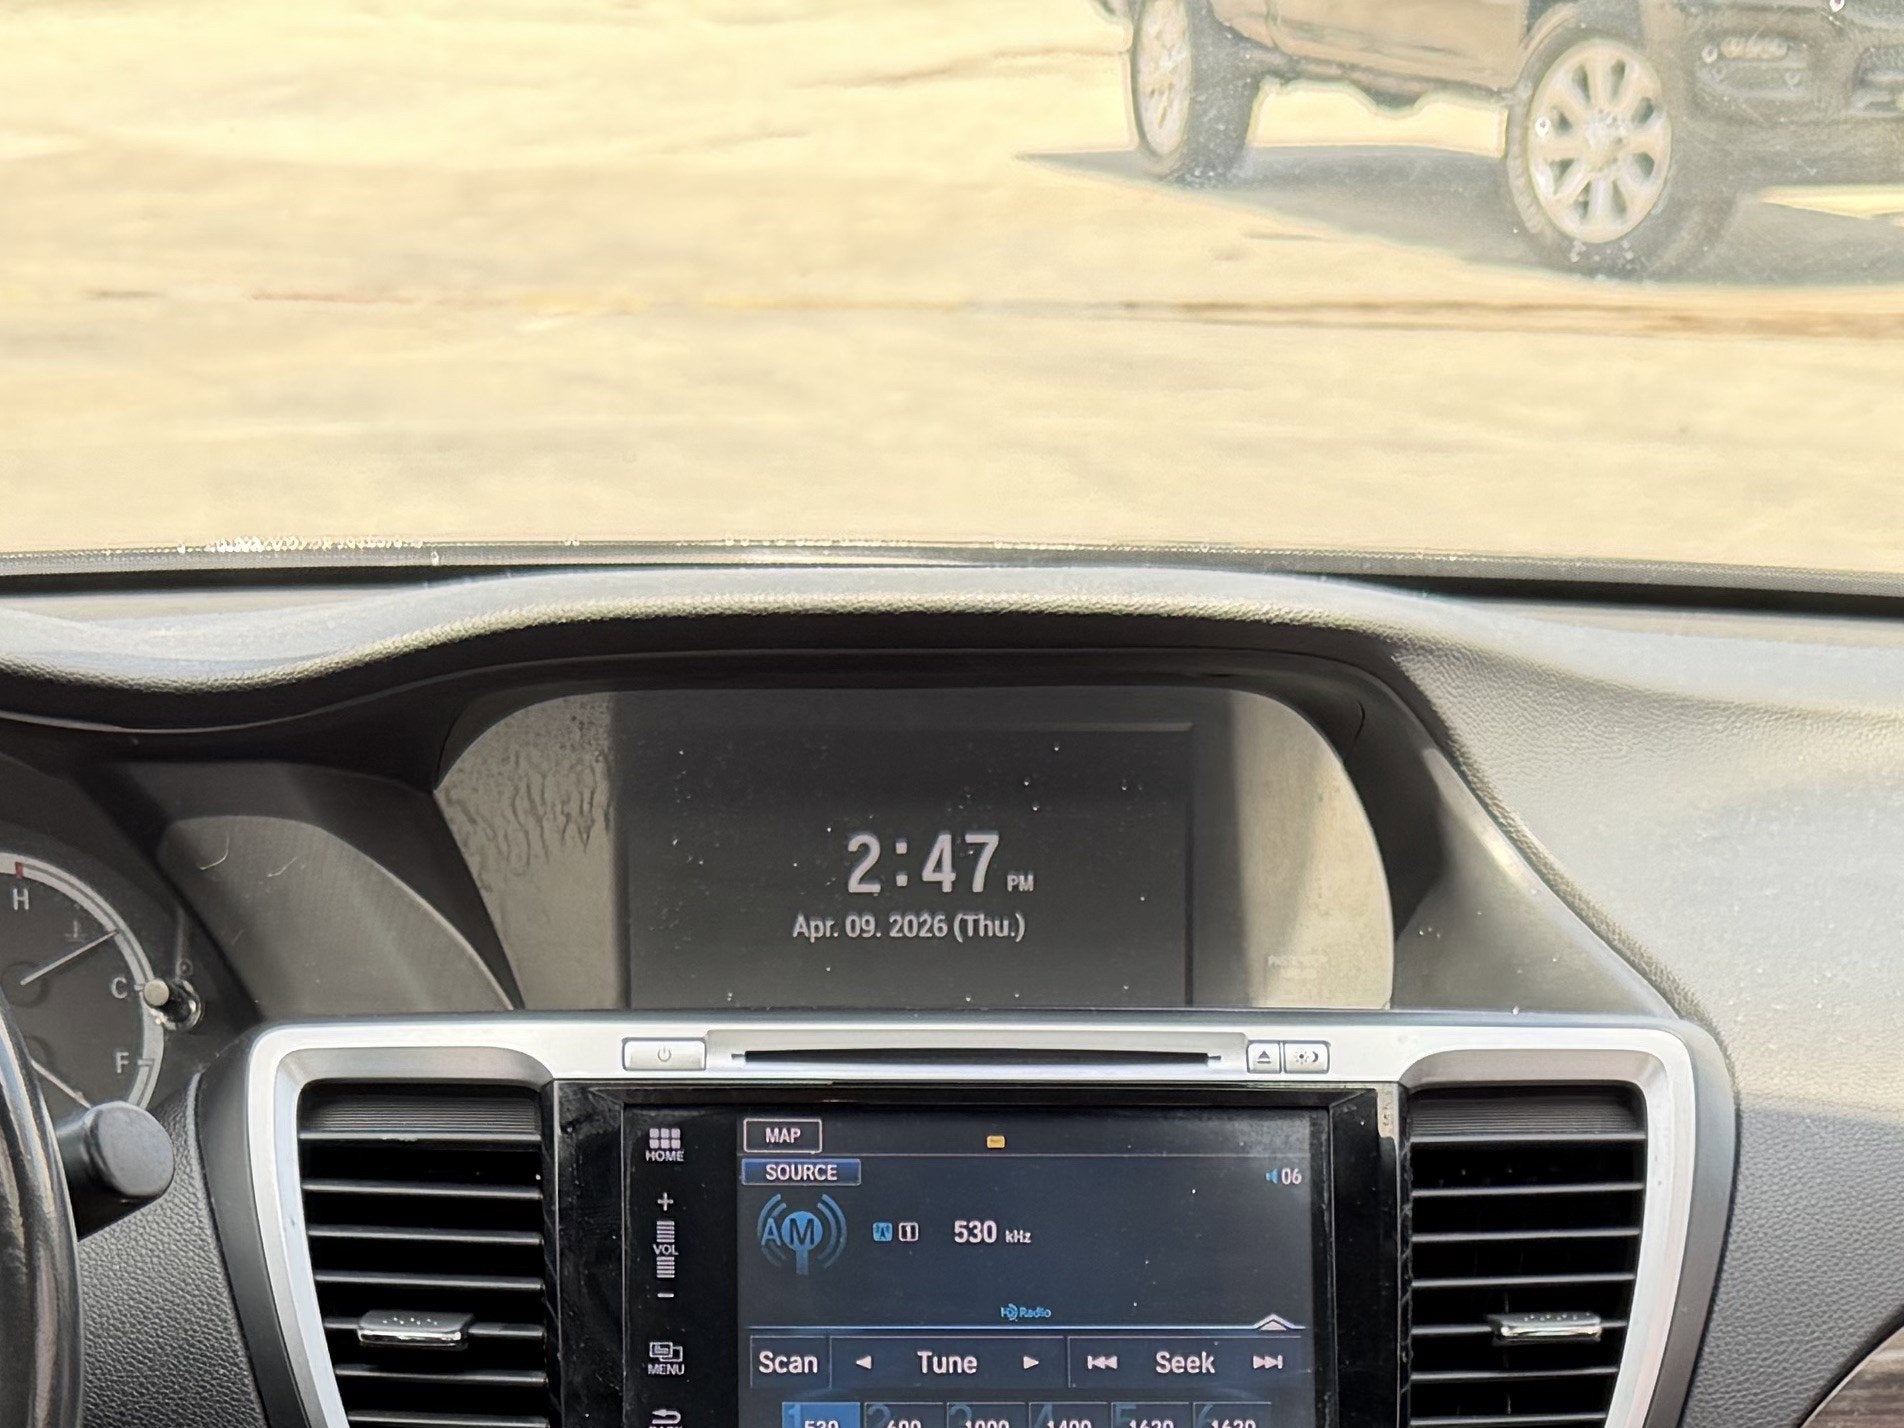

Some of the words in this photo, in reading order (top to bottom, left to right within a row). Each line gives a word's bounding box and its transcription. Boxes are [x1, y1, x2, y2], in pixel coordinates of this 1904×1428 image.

[847, 833, 1000, 893] 2:47
[1006, 873, 1035, 892] PM
[12, 888, 30, 911] H
[792, 913, 839, 943] Apr.
[845, 912, 882, 938] 09.
[888, 912, 949, 938] 2026
[953, 910, 1026, 943] (Thu.)
[110, 976, 128, 999] C
[115, 1051, 130, 1074] F
[764, 1127, 802, 1144] MAP
[645, 1150, 685, 1162] HOME
[764, 1164, 839, 1181] SOURCE
[1280, 1167, 1303, 1185] 06
[953, 1219, 998, 1244] 530
[1005, 1229, 1032, 1244] kHz
[653, 1243, 679, 1256] VOL
[1019, 1306, 1052, 1319] Radio
[647, 1364, 686, 1376] MENU
[758, 1350, 819, 1374] Scan
[917, 1350, 978, 1374] Tune
[1155, 1350, 1216, 1374] Seek
